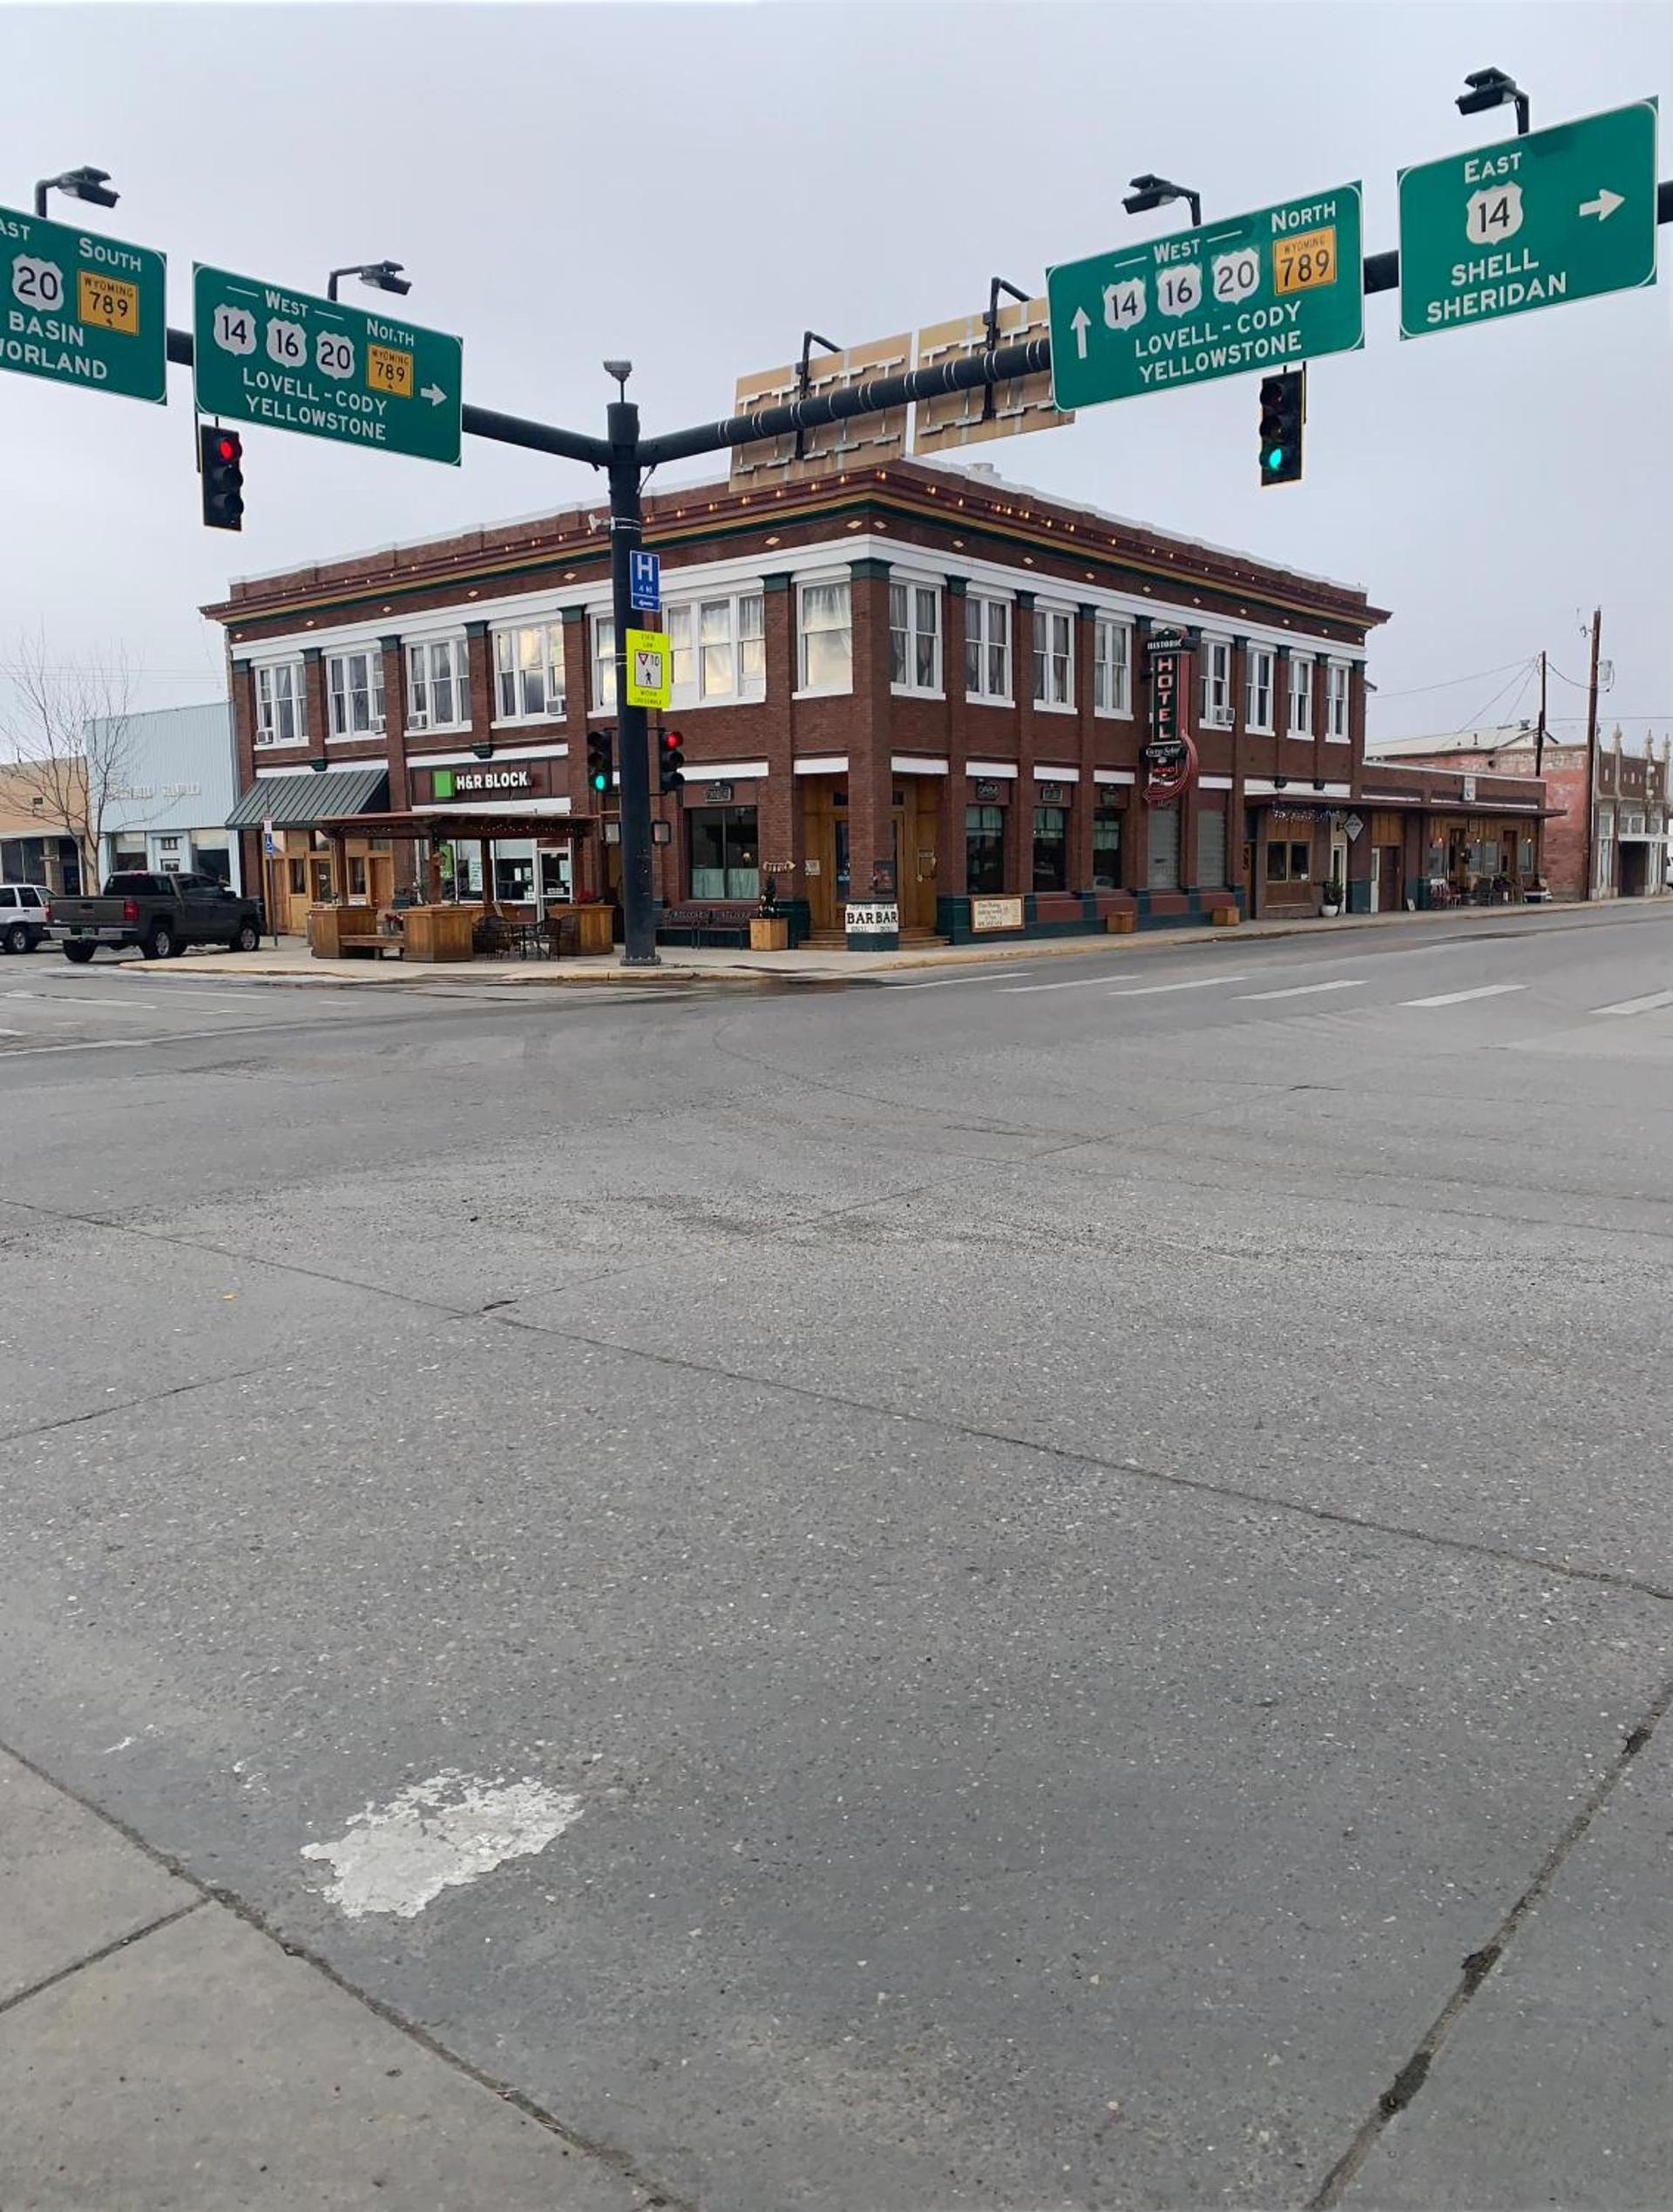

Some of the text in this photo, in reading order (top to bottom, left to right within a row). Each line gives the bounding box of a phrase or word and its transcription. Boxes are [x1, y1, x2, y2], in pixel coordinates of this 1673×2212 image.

[1464, 152, 1522, 184] EAST
[1270, 200, 1336, 233] NORTH
[1479, 196, 1510, 233] 14
[78, 237, 141, 272] SOUTH
[1154, 239, 1201, 264] WEST
[1284, 236, 1325, 254] WYOMING
[1217, 260, 1255, 294] 20
[1280, 249, 1330, 287] 789
[1451, 247, 1539, 287] SHELL
[18, 266, 58, 301] 20
[84, 276, 133, 298] WYOMING
[1166, 277, 1193, 306] 16
[1426, 271, 1567, 323] SHERIDAN
[89, 291, 129, 317] 789
[265, 289, 308, 317] WEST
[1111, 291, 1138, 320] 14
[9, 310, 84, 347] BASIN
[223, 315, 247, 344] 14
[276, 328, 299, 357] 16
[321, 341, 350, 369] 20
[1140, 330, 1302, 384] YELLOWSTONE
[376, 361, 405, 382] 789
[245, 394, 386, 441] YELLOWSTONE
[637, 554, 653, 581] H
[1158, 658, 1173, 739] HOTEL
[456, 771, 527, 790] H&R BLOCK
[846, 912, 874, 924] BAR
[876, 911, 898, 923] BAR
